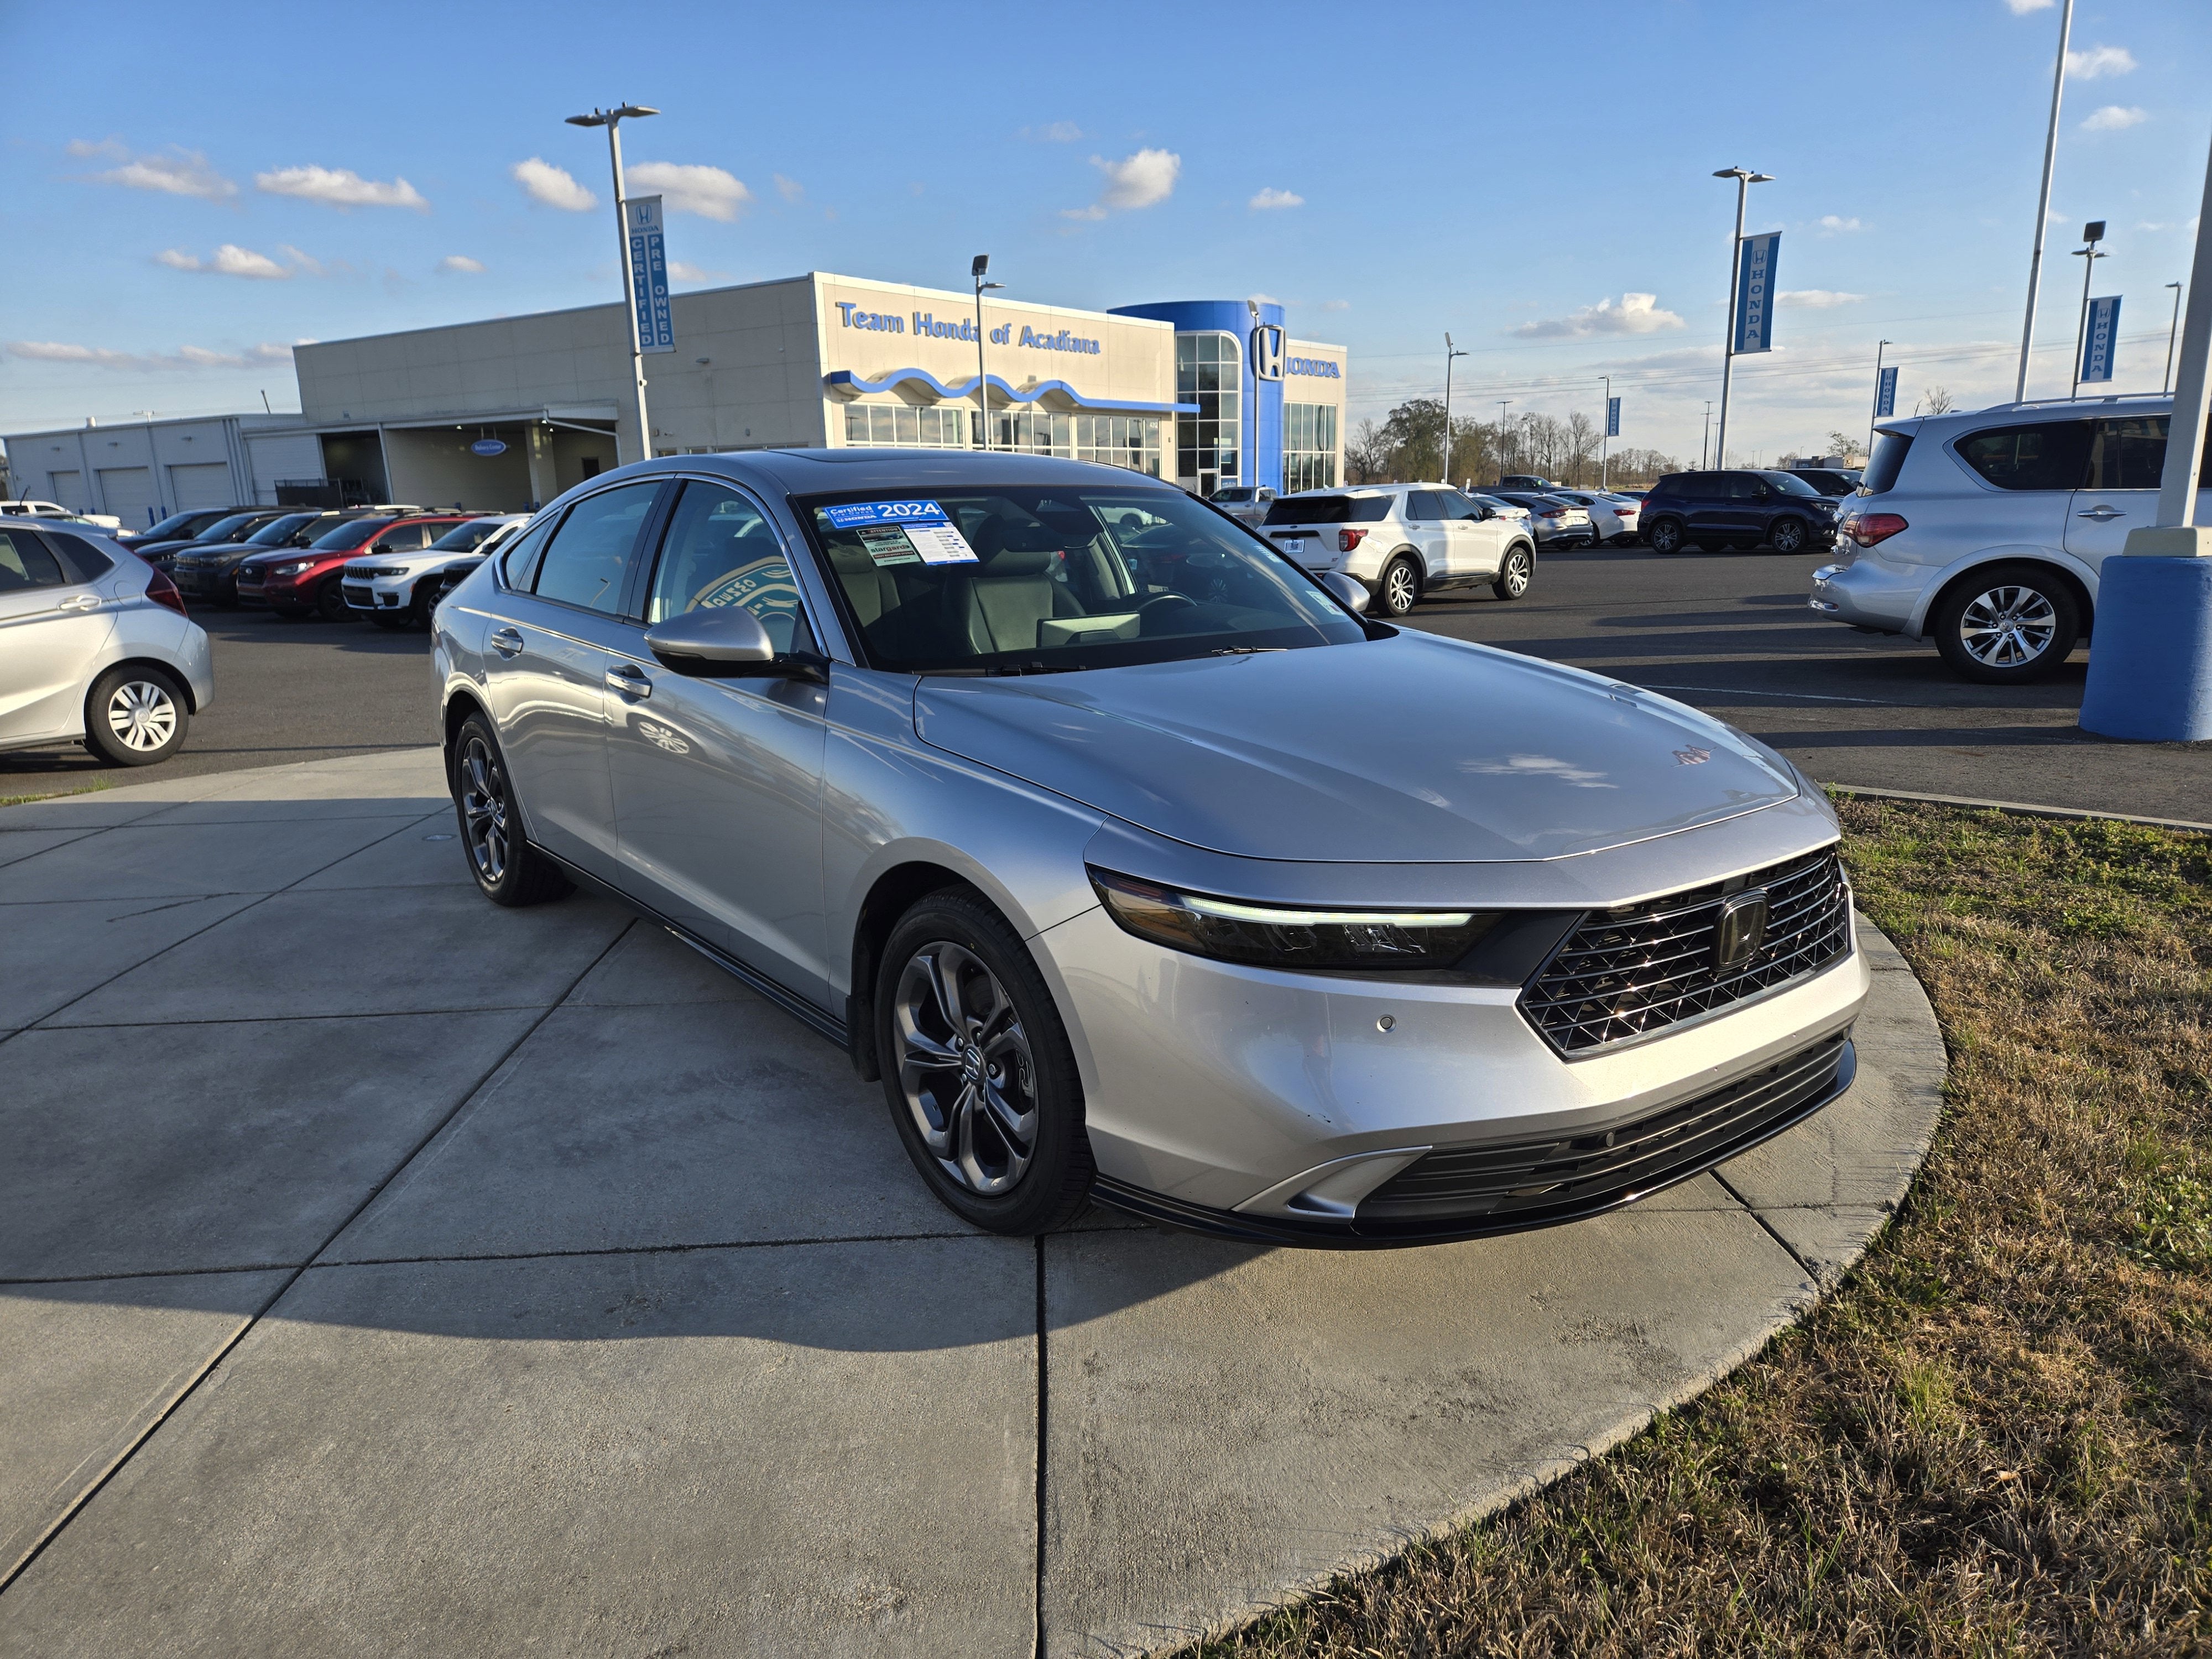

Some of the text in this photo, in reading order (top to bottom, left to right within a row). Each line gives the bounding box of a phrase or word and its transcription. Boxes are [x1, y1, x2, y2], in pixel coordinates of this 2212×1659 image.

[631, 225, 659, 234] HONDA
[632, 238, 652, 345] CERTIFIED
[650, 236, 670, 343] PRE OWNED
[1746, 269, 1765, 339] HONDA
[836, 301, 1102, 354] Team Honda of Acadiana
[2091, 322, 2109, 373] HONDA
[830, 505, 873, 514] Certified
[878, 503, 940, 517] 2024
